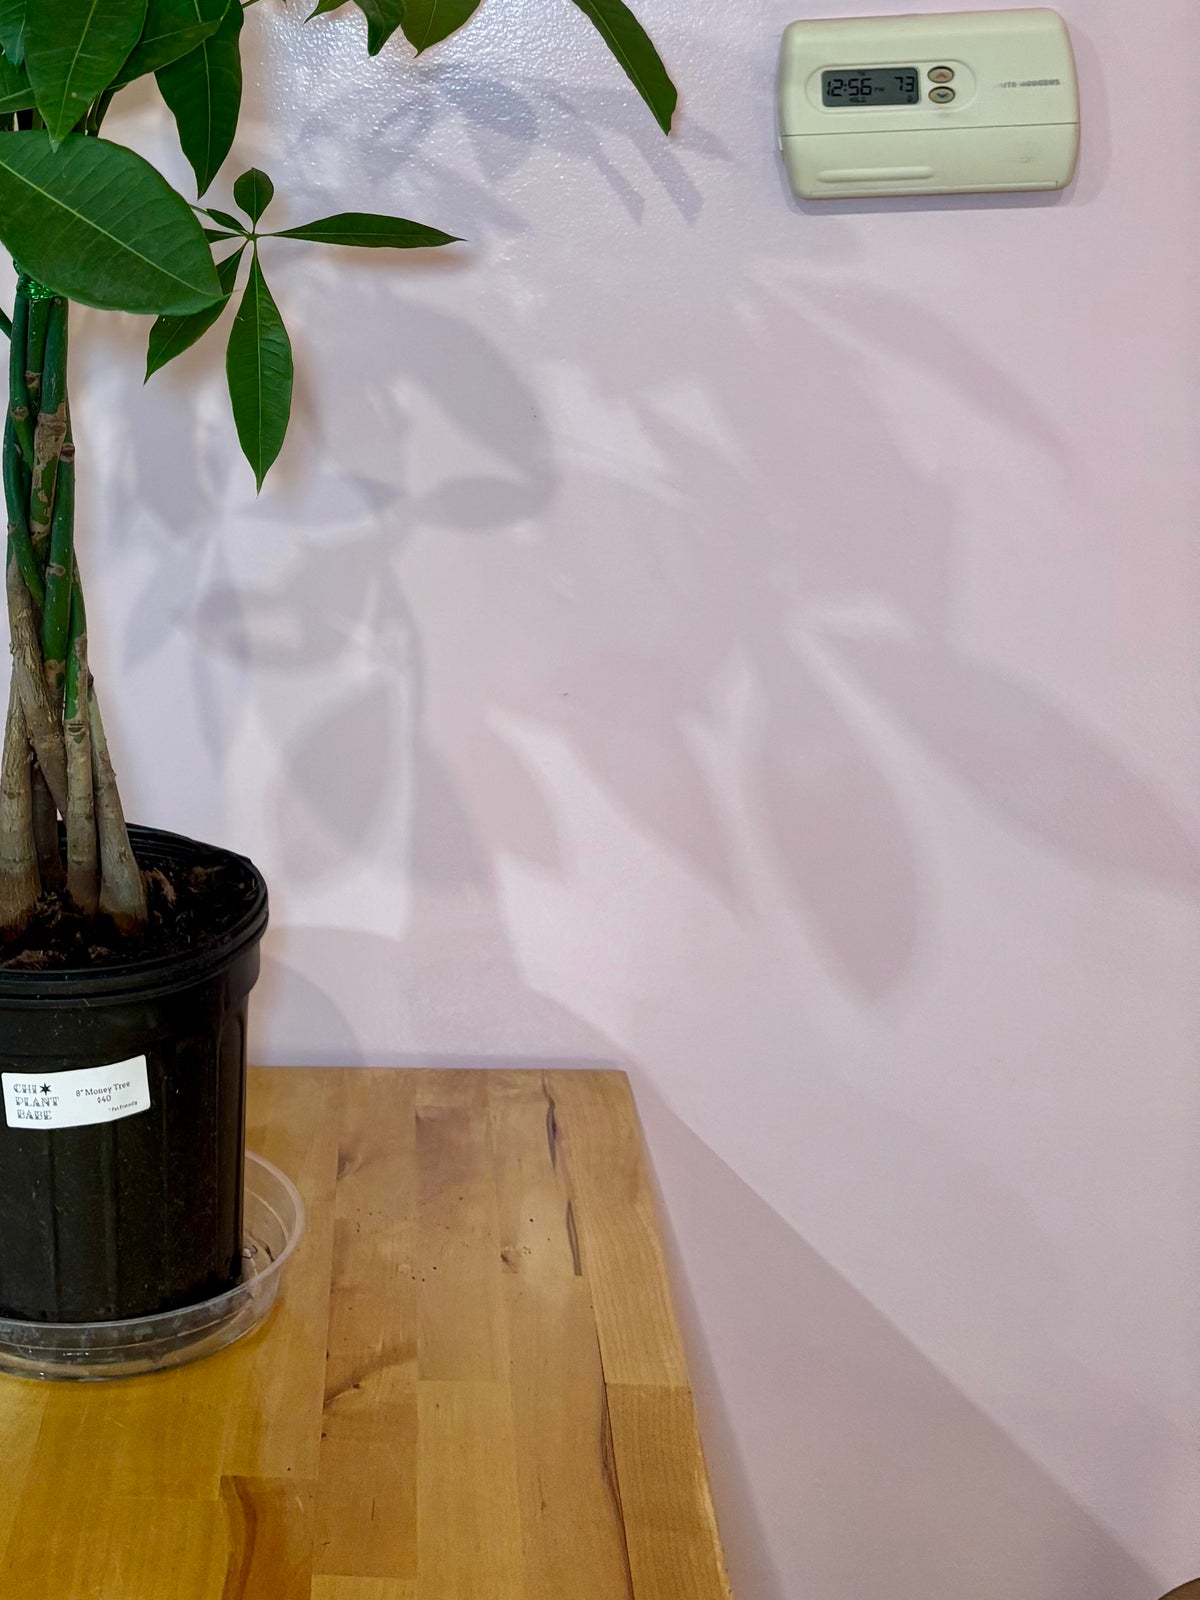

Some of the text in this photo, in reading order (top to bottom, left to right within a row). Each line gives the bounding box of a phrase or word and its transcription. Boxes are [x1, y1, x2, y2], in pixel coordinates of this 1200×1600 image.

[827, 78, 872, 97] 12:56
[894, 76, 915, 93] 73
[13, 1083, 37, 1094] CHI
[85, 1086, 112, 1097] Money
[113, 1081, 130, 1091] Tree
[15, 1096, 59, 1107] PLANT
[97, 1095, 112, 1104] $40
[17, 1109, 52, 1120] BABE
